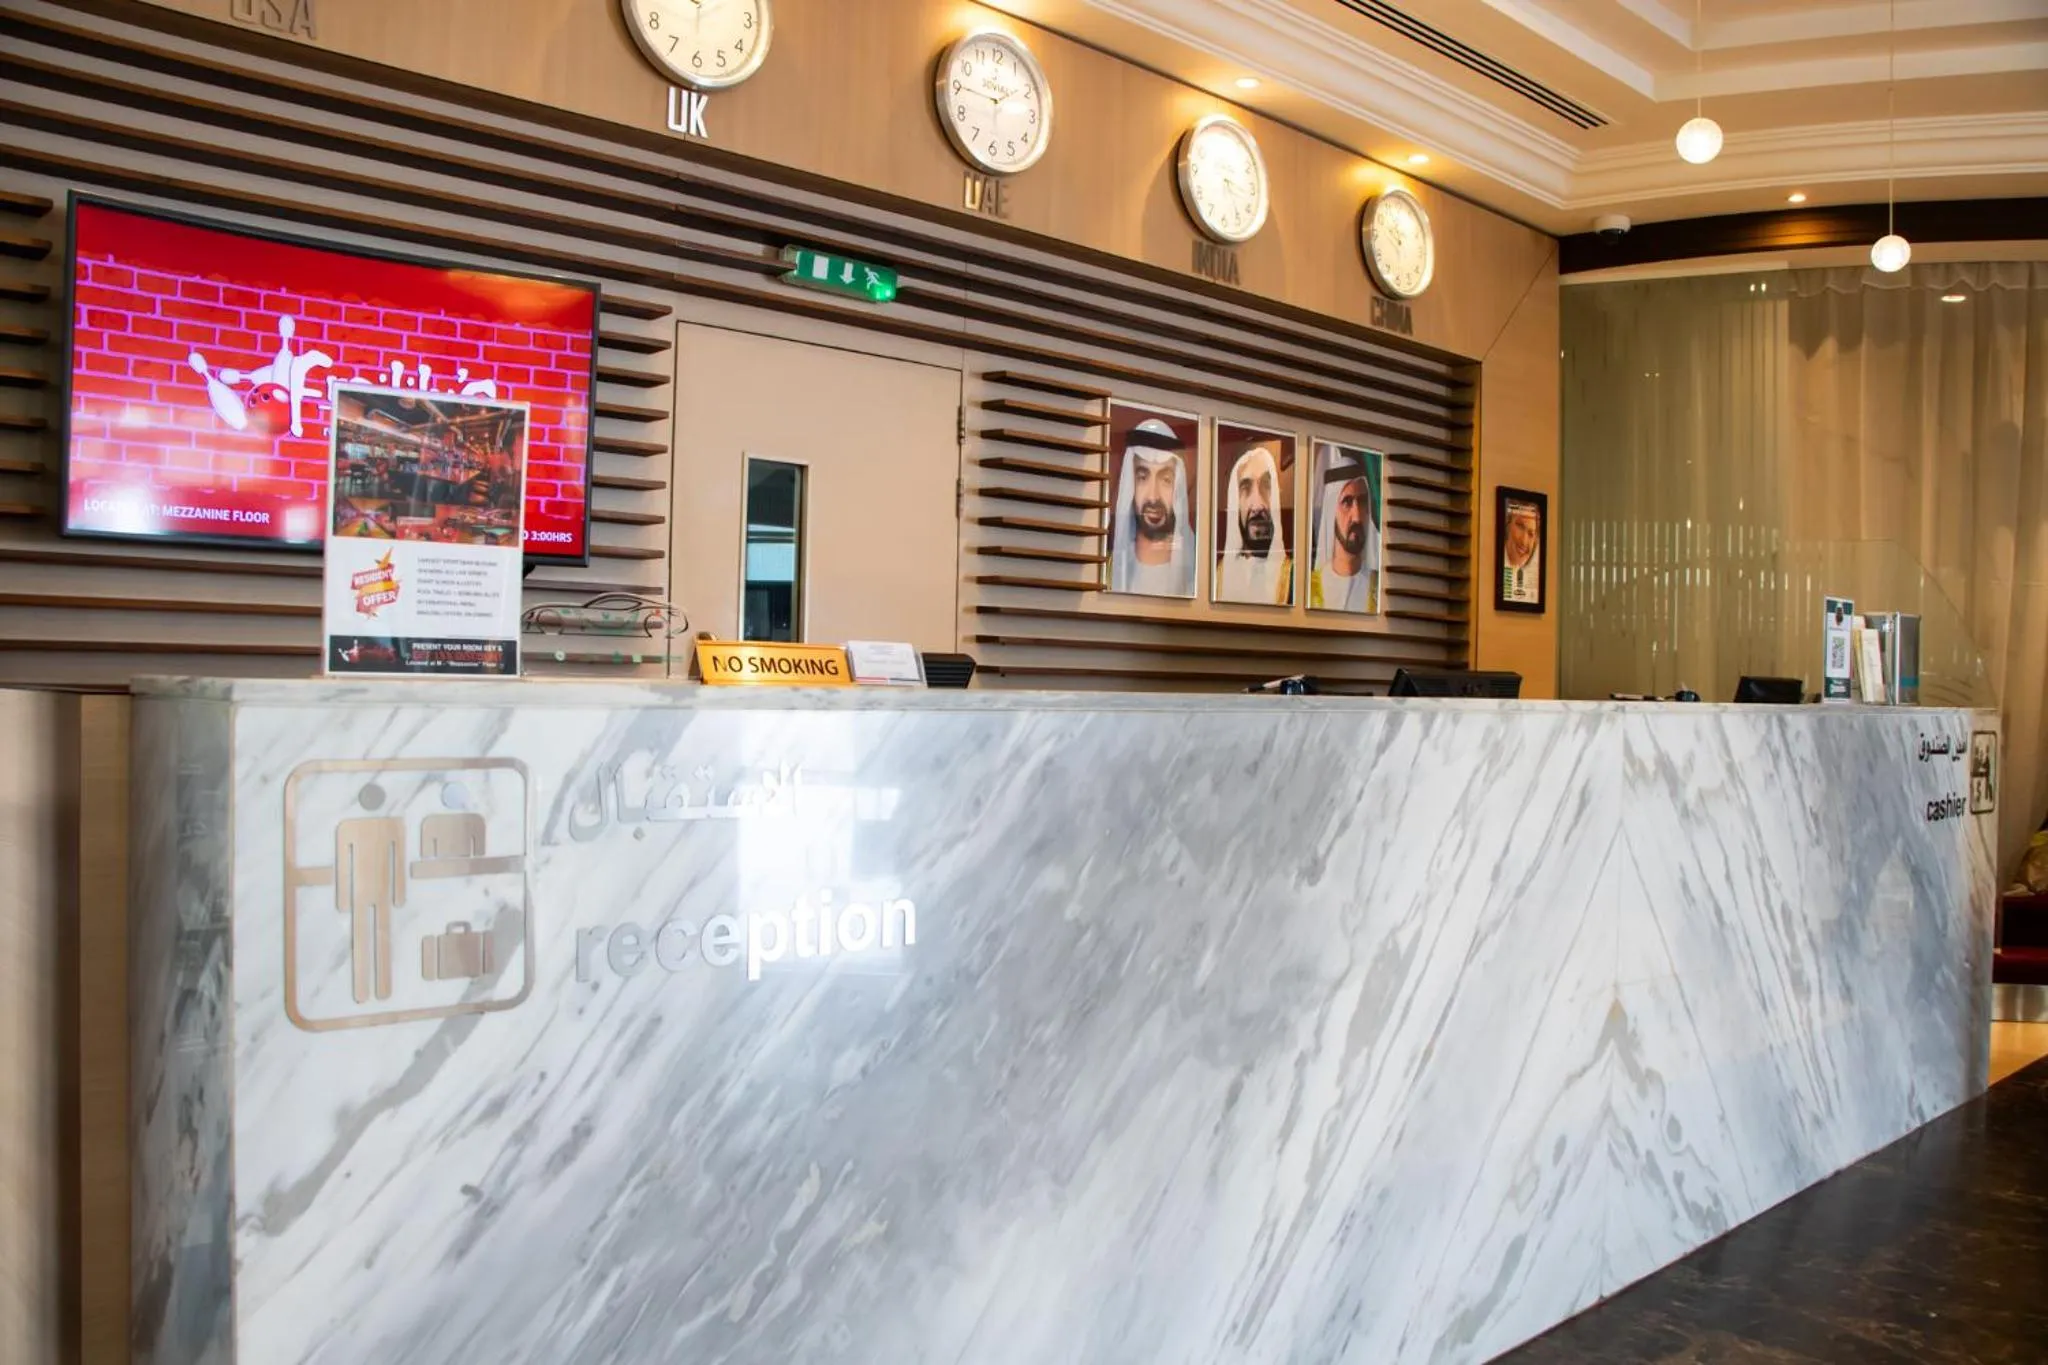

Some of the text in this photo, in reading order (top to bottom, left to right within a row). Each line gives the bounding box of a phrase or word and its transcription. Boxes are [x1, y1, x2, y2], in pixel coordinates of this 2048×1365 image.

[649, 11, 660, 30] 8
[743, 11, 753, 29] 3
[668, 34, 680, 53] 7
[734, 38, 744, 54] 4
[691, 51, 703, 68] 6
[716, 50, 727, 67] 5
[992, 47, 1004, 65] 12
[953, 79, 962, 96] 9
[1024, 83, 1032, 99] 2
[667, 86, 709, 139] UK
[957, 105, 966, 122] 8
[1029, 109, 1036, 124] 3
[971, 126, 980, 142] 7
[1020, 131, 1028, 144] 4
[988, 141, 997, 156] 6
[1006, 141, 1015, 156] 5
[963, 172, 1010, 219] UAE
[162, 506, 231, 521] MEZZANINE
[232, 510, 270, 523] FLOOR
[531, 530, 573, 543] 3:00HRS
[363, 592, 396, 606] OFFER
[712, 655, 839, 676] NO SMOKING
[1926, 792, 1967, 821] cashier
[575, 888, 917, 983] reception
